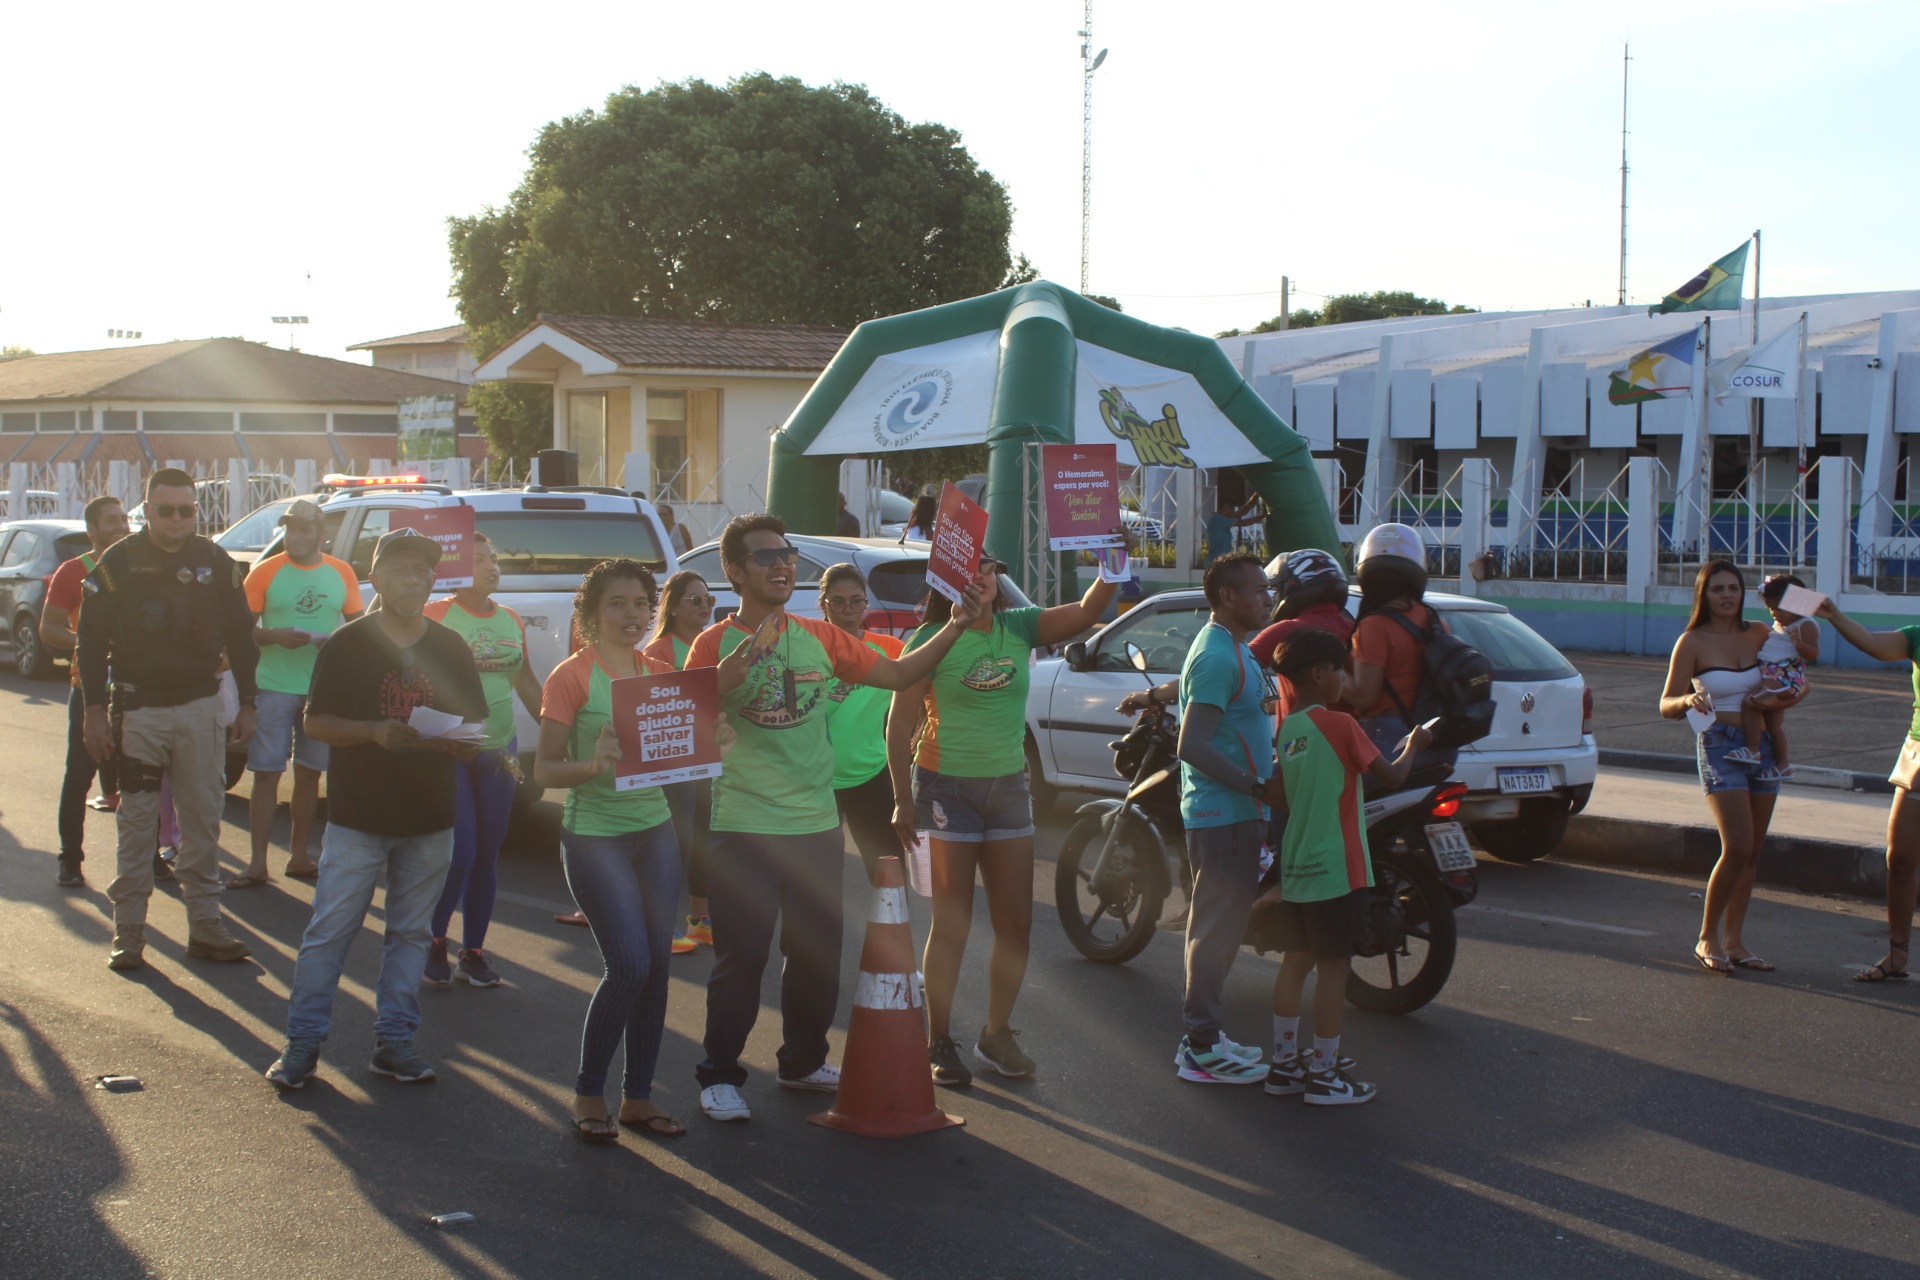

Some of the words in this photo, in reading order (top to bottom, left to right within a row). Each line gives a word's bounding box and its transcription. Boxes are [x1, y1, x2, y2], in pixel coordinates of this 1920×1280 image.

[1729, 375, 1781, 388] COSUR
[920, 412, 940, 430] BOA
[894, 430, 919, 447] VISTA
[1065, 469, 1104, 479] Hemoraima
[1053, 482, 1077, 491] espera
[1092, 480, 1109, 488] você!
[942, 512, 953, 528] Sou
[953, 523, 962, 534] do
[962, 529, 974, 544] tipo
[939, 527, 951, 539] que
[951, 533, 974, 557] estende
[942, 539, 956, 556] mão
[954, 550, 968, 566] para
[935, 548, 952, 566] quem
[951, 559, 974, 582] precisa!
[650, 686, 680, 699] Sou
[636, 699, 696, 715] doador,
[763, 715, 777, 724] DO
[779, 687, 821, 723] LAVRADO
[638, 714, 682, 731] ajudo
[685, 713, 695, 724] a
[643, 729, 691, 745] salvar
[647, 744, 689, 759] vidas
[1503, 774, 1545, 791] NAT3A37
